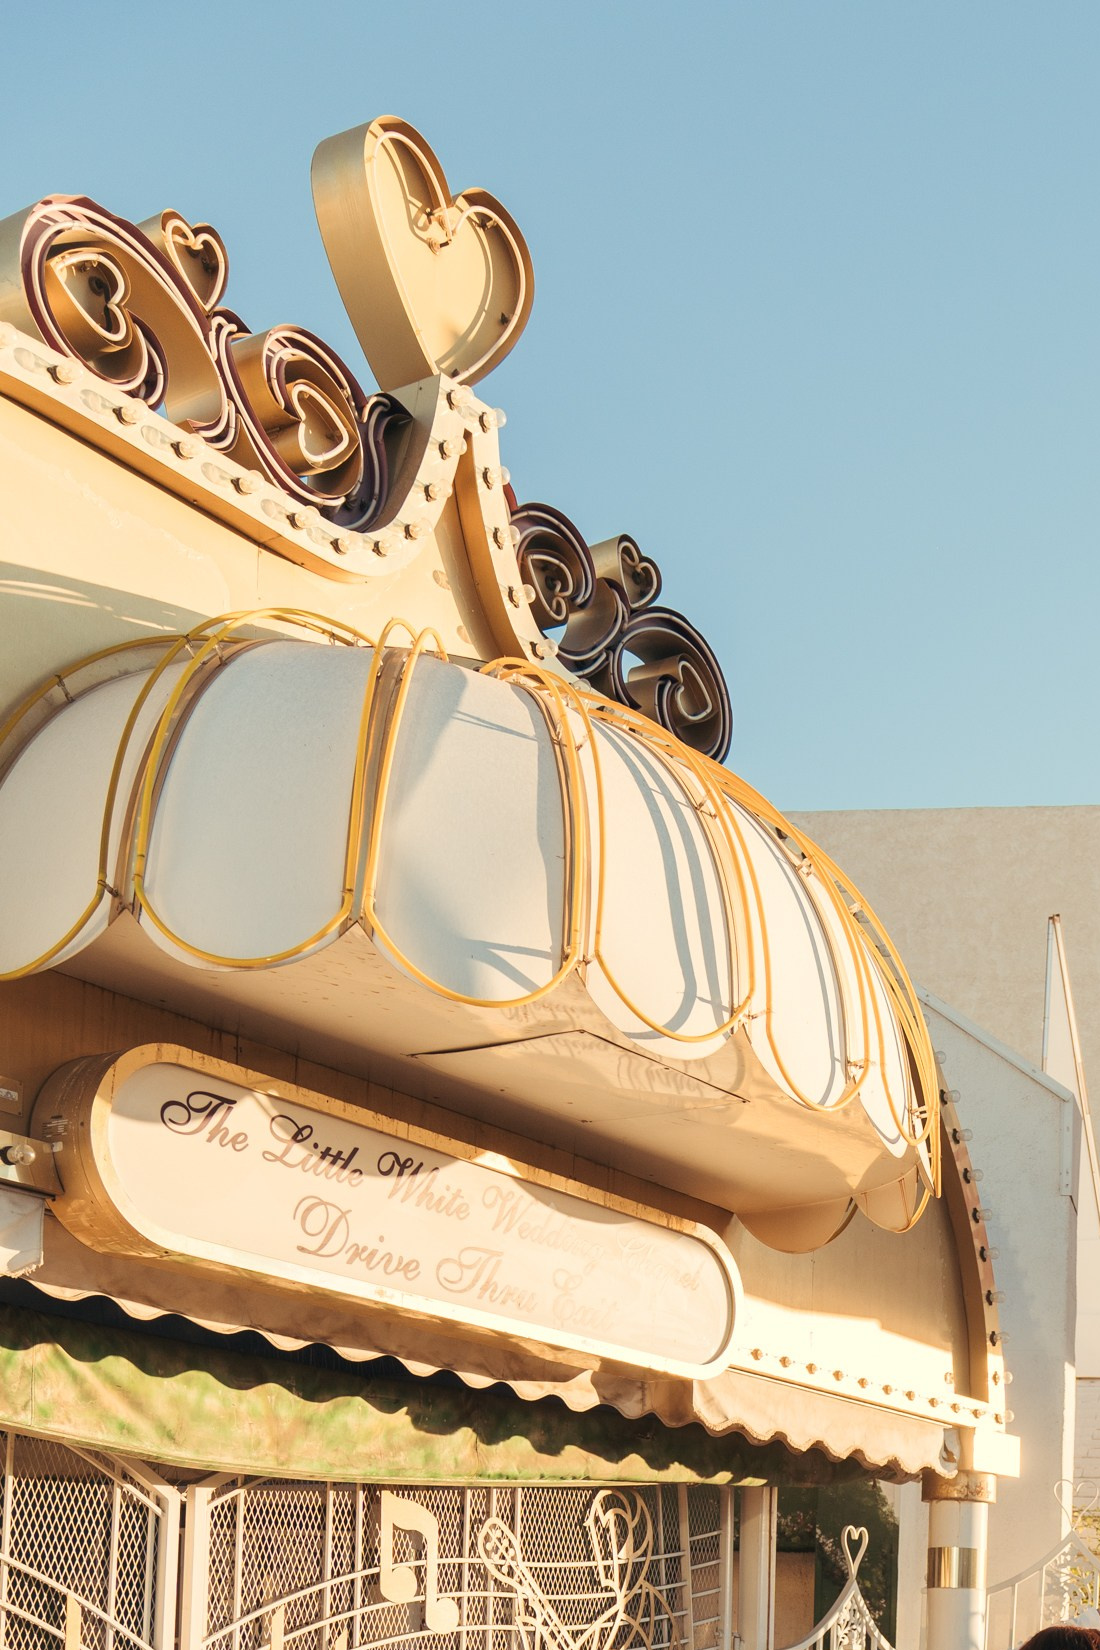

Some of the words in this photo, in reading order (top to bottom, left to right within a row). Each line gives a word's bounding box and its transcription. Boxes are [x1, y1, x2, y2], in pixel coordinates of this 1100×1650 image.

[160, 1091, 249, 1152] The
[262, 1114, 364, 1187] Little
[377, 1151, 470, 1221] White
[482, 1185, 607, 1276] Wedding
[293, 1195, 421, 1281] Drive
[436, 1246, 537, 1313] Thru
